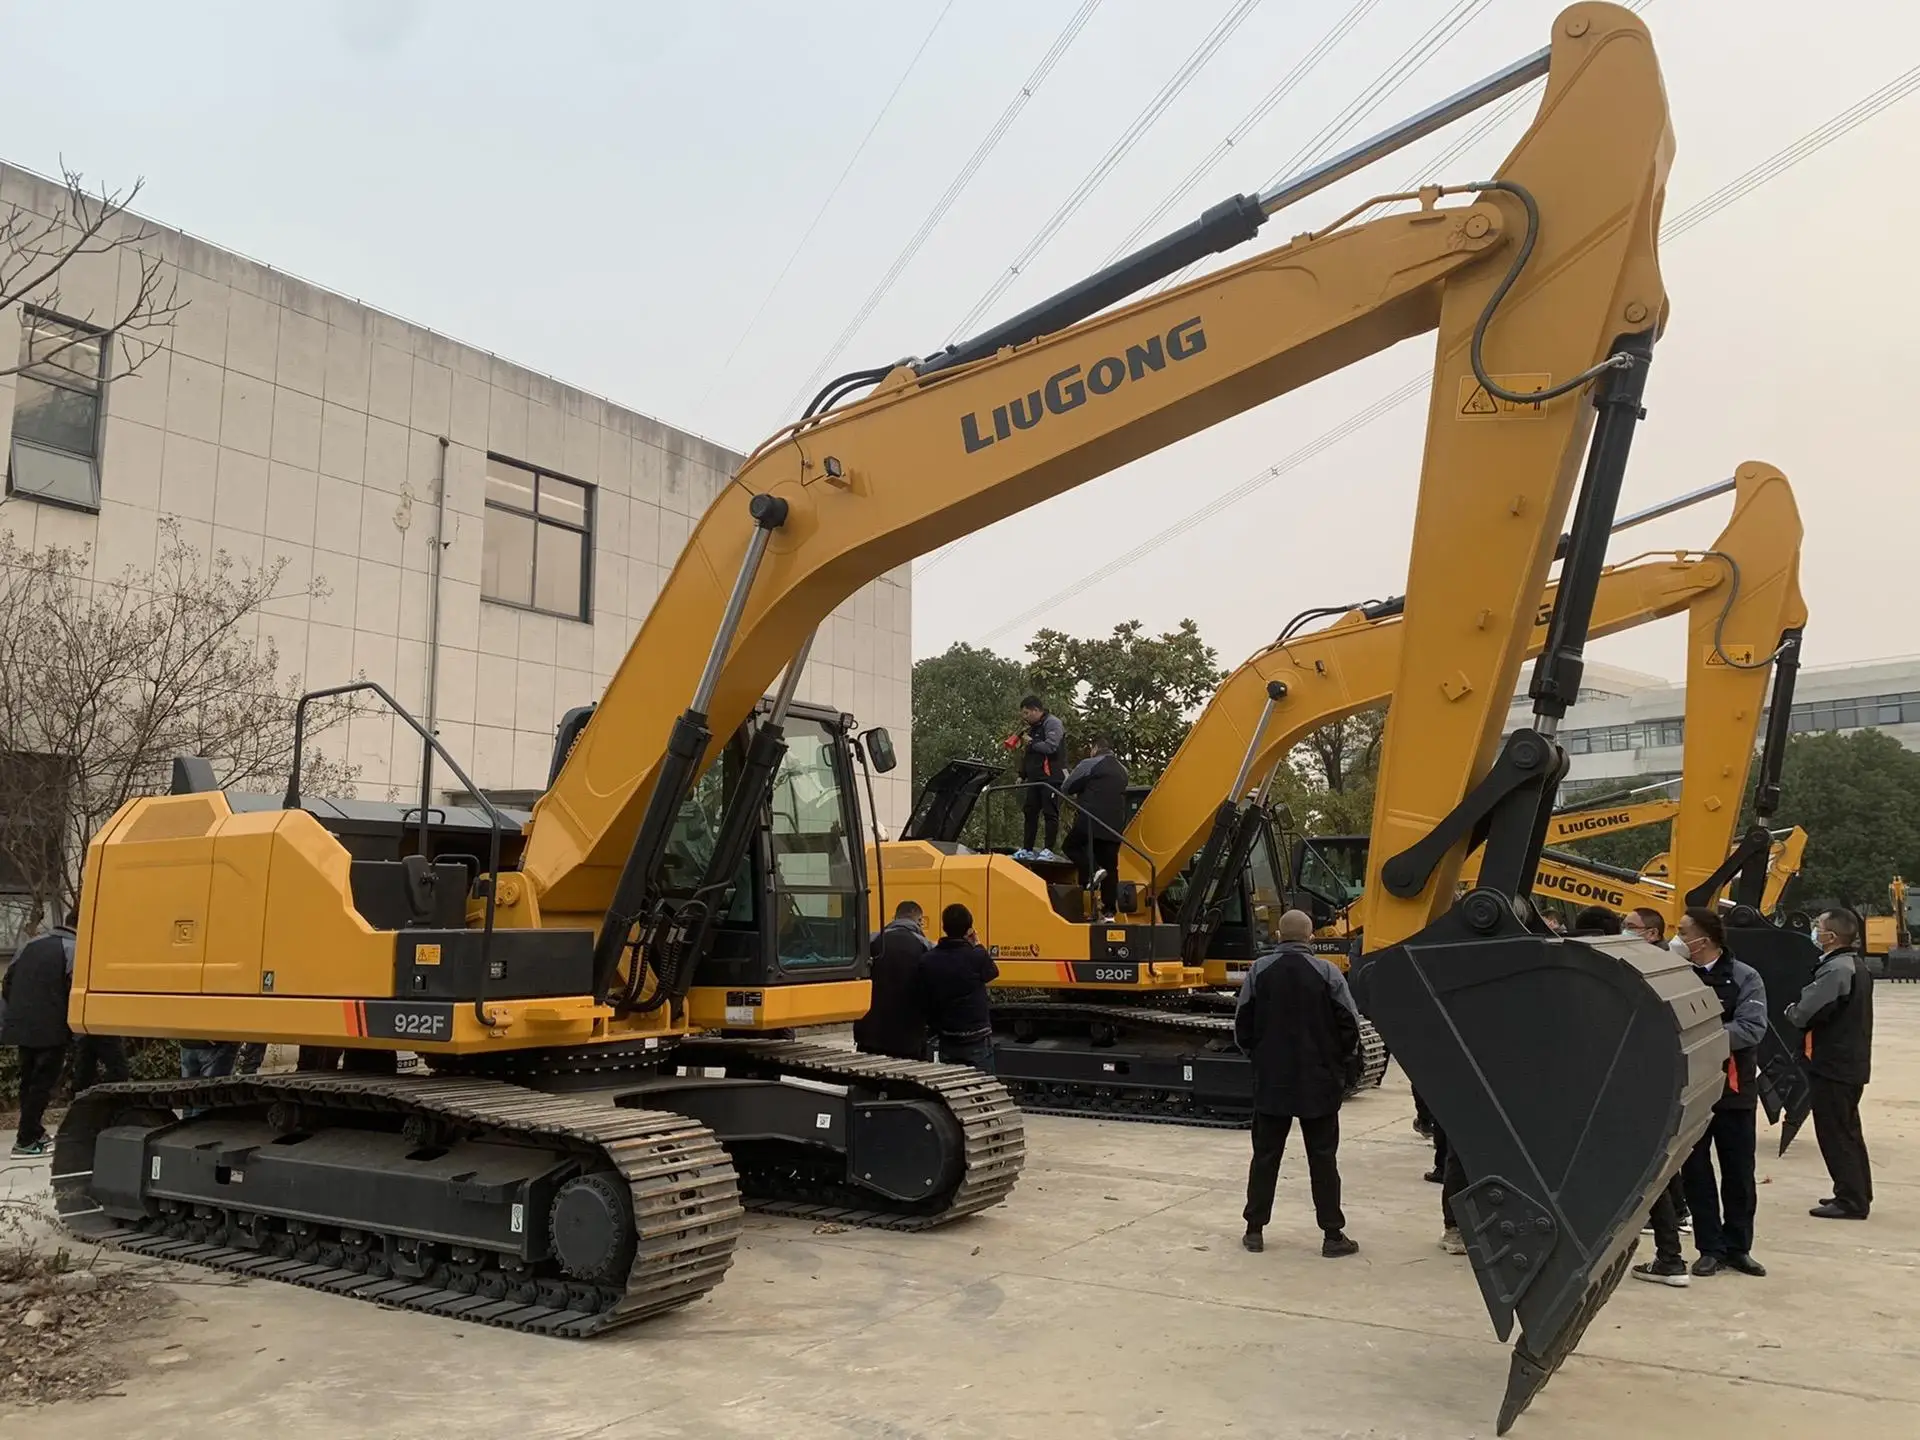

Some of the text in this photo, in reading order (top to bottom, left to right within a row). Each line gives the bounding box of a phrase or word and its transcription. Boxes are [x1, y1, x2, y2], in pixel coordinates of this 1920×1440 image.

[960, 316, 1207, 454] LIUGONG
[1558, 813, 1630, 835] LIUGONG
[1535, 872, 1624, 906] IUGONG
[1095, 969, 1133, 981] 920F
[395, 1014, 445, 1035] 922F
